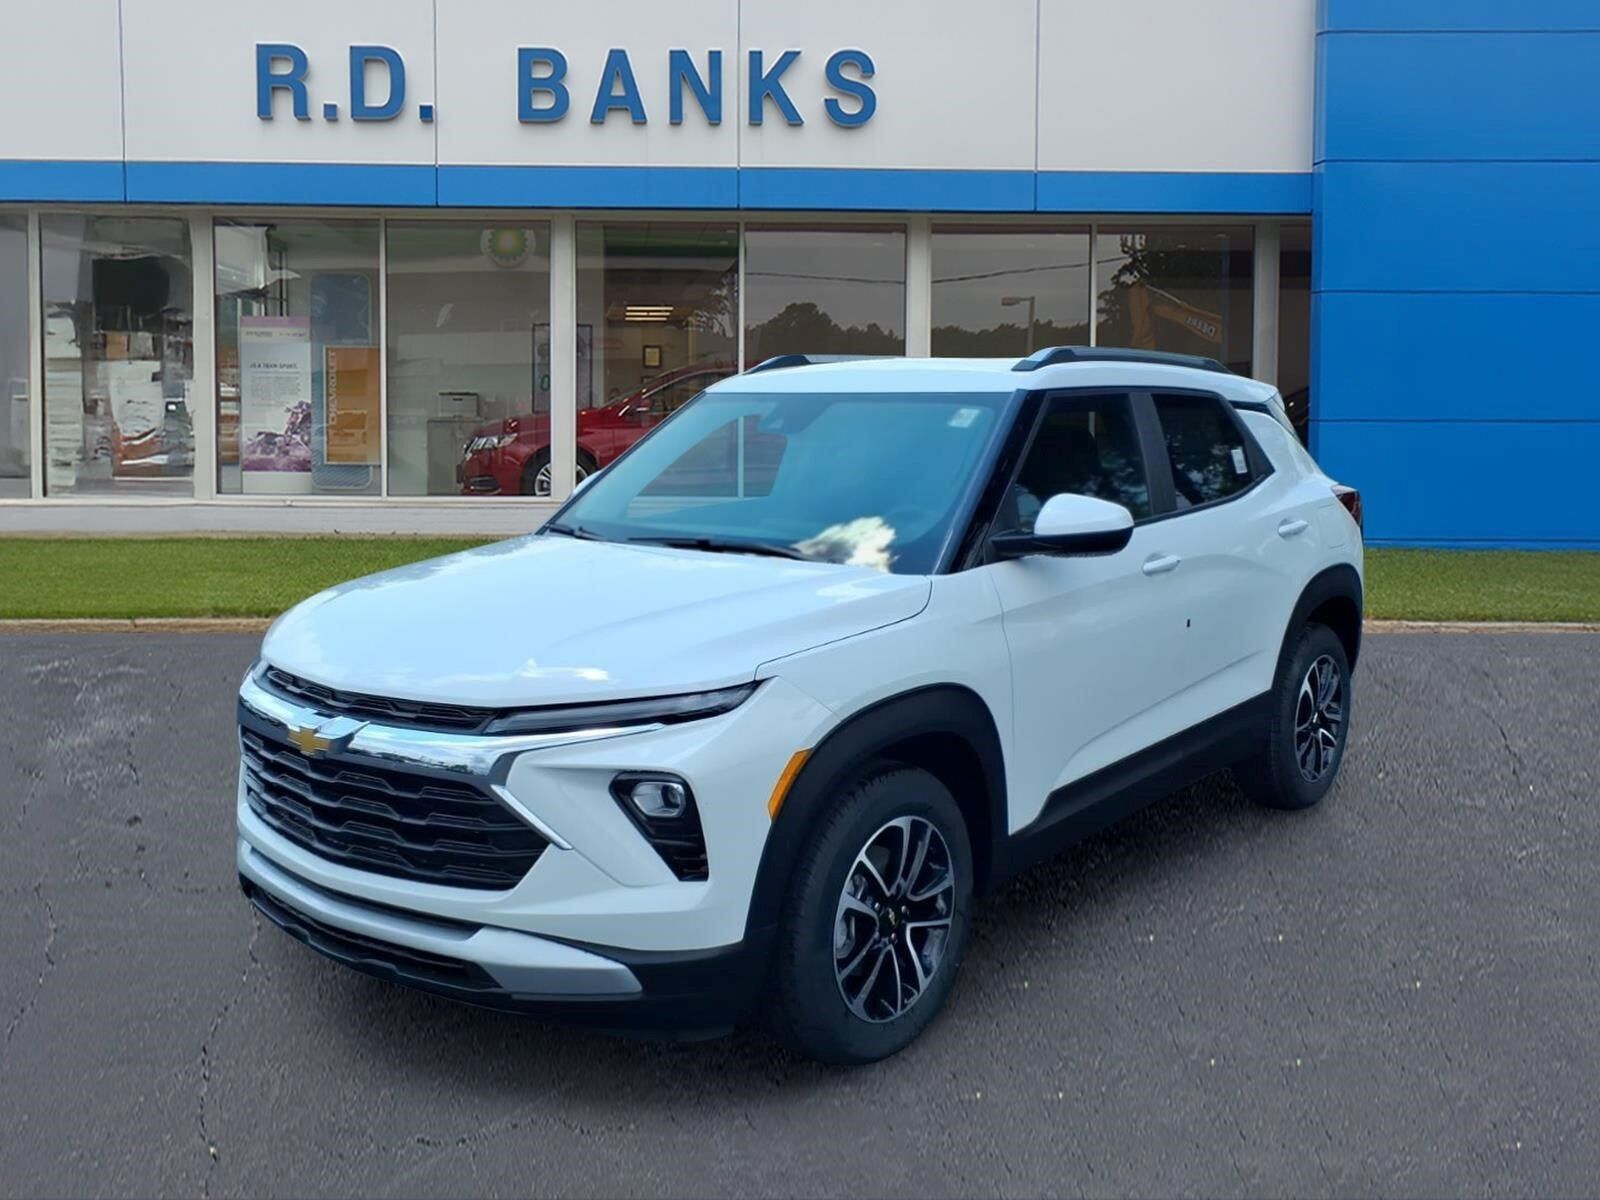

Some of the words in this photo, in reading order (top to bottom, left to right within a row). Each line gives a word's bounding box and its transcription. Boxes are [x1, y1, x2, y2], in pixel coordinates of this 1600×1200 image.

[256, 43, 434, 121] R.D.
[517, 47, 878, 128] BANKS
[328, 349, 337, 425] CHEVROLET
